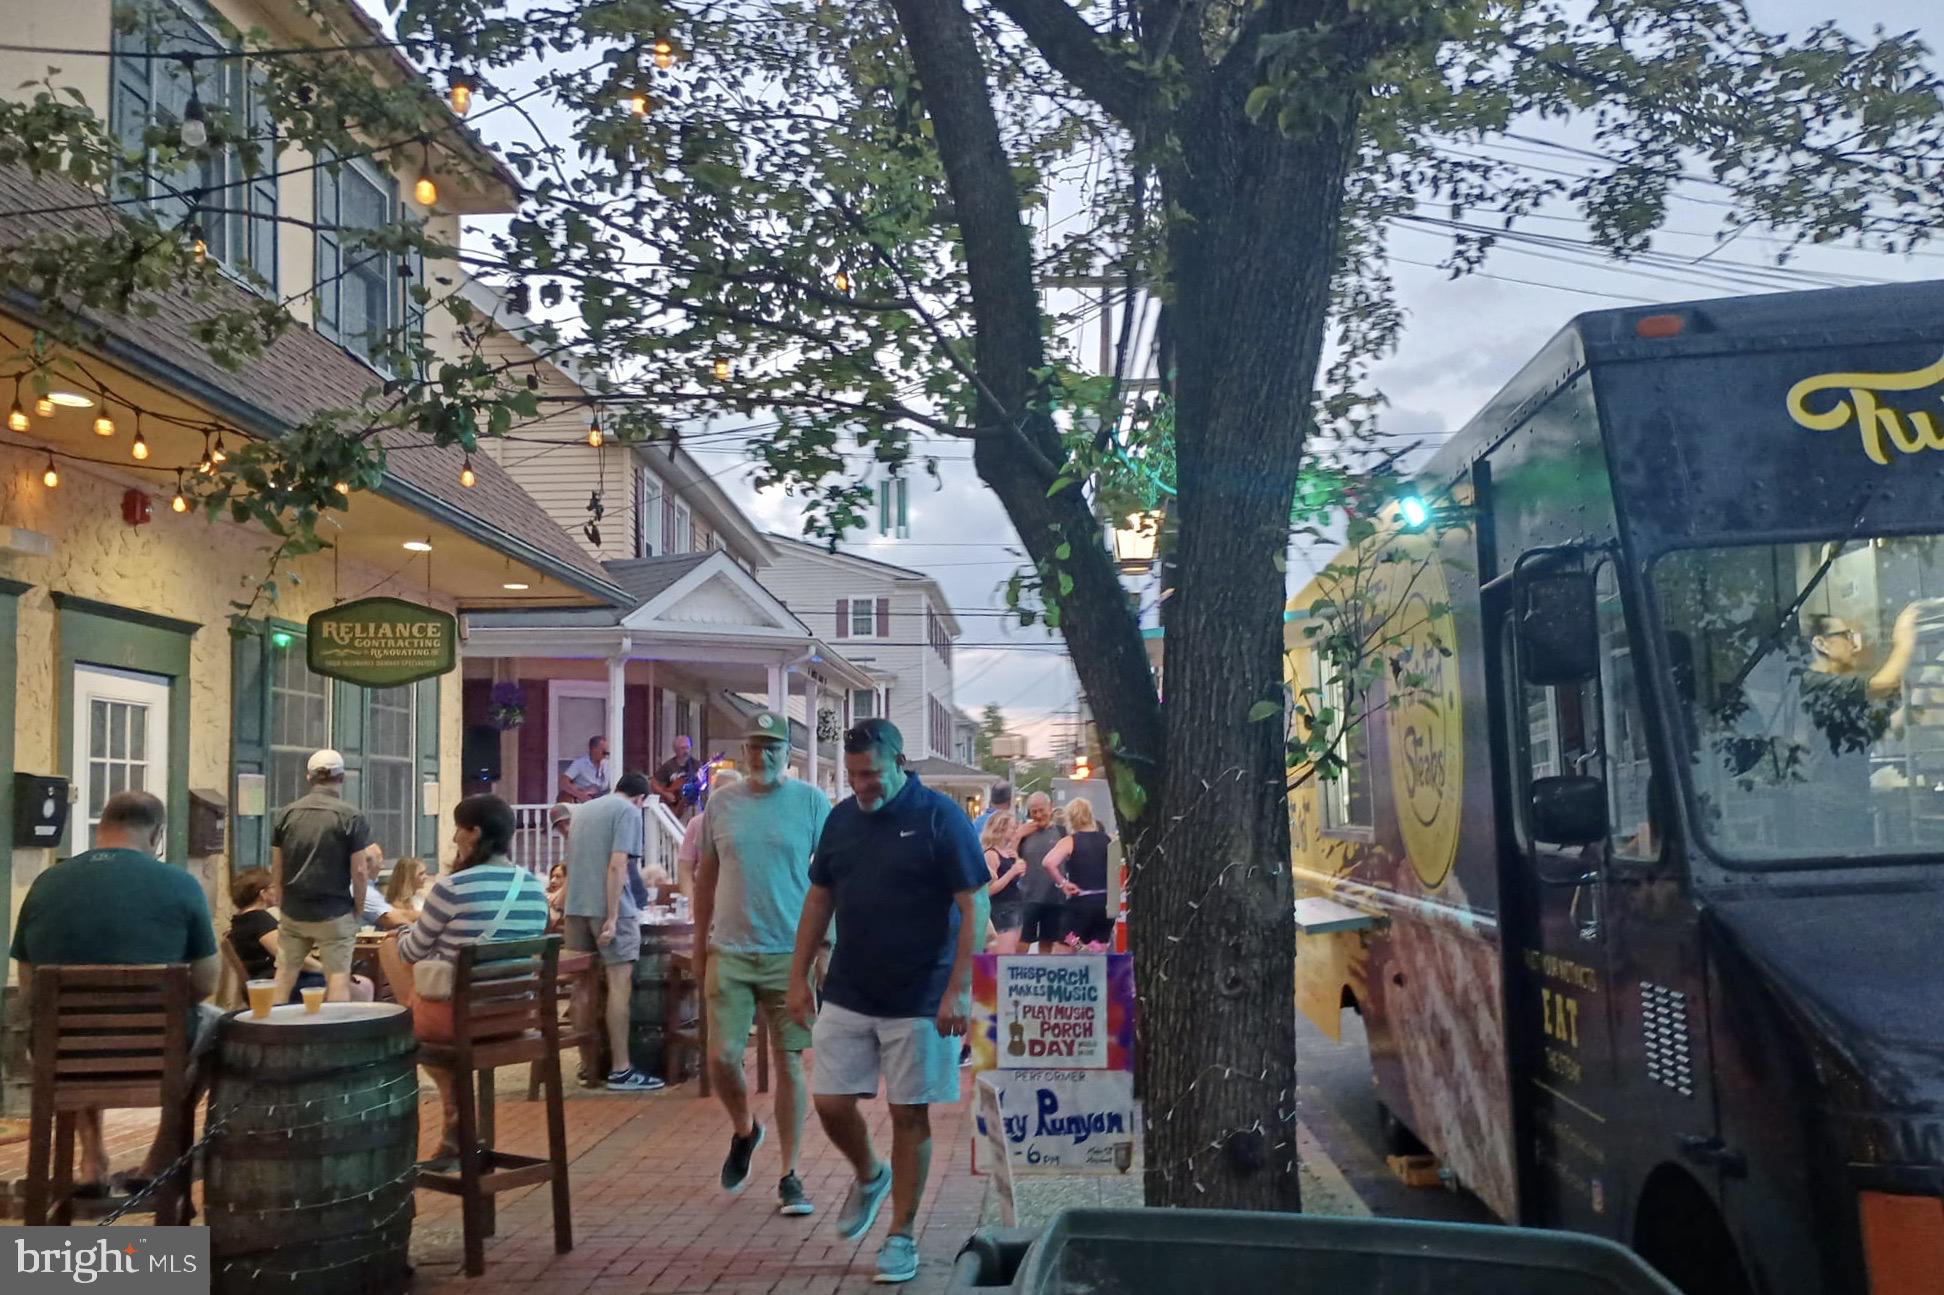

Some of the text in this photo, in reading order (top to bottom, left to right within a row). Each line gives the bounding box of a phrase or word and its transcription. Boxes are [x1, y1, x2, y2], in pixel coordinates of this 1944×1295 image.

[322, 621, 441, 645] RELIANCE
[354, 638, 441, 648] CONTRACTING
[370, 649, 430, 658] RENOVATING
[1008, 984, 1046, 998] MAKES
[1022, 1005, 1054, 1020] PLAY
[1040, 1021, 1093, 1038] PORCH
[1028, 1039, 1075, 1057] DAY
[1014, 1071, 1087, 1082] PERFORMER
[1034, 1088, 1124, 1145] Runyan
